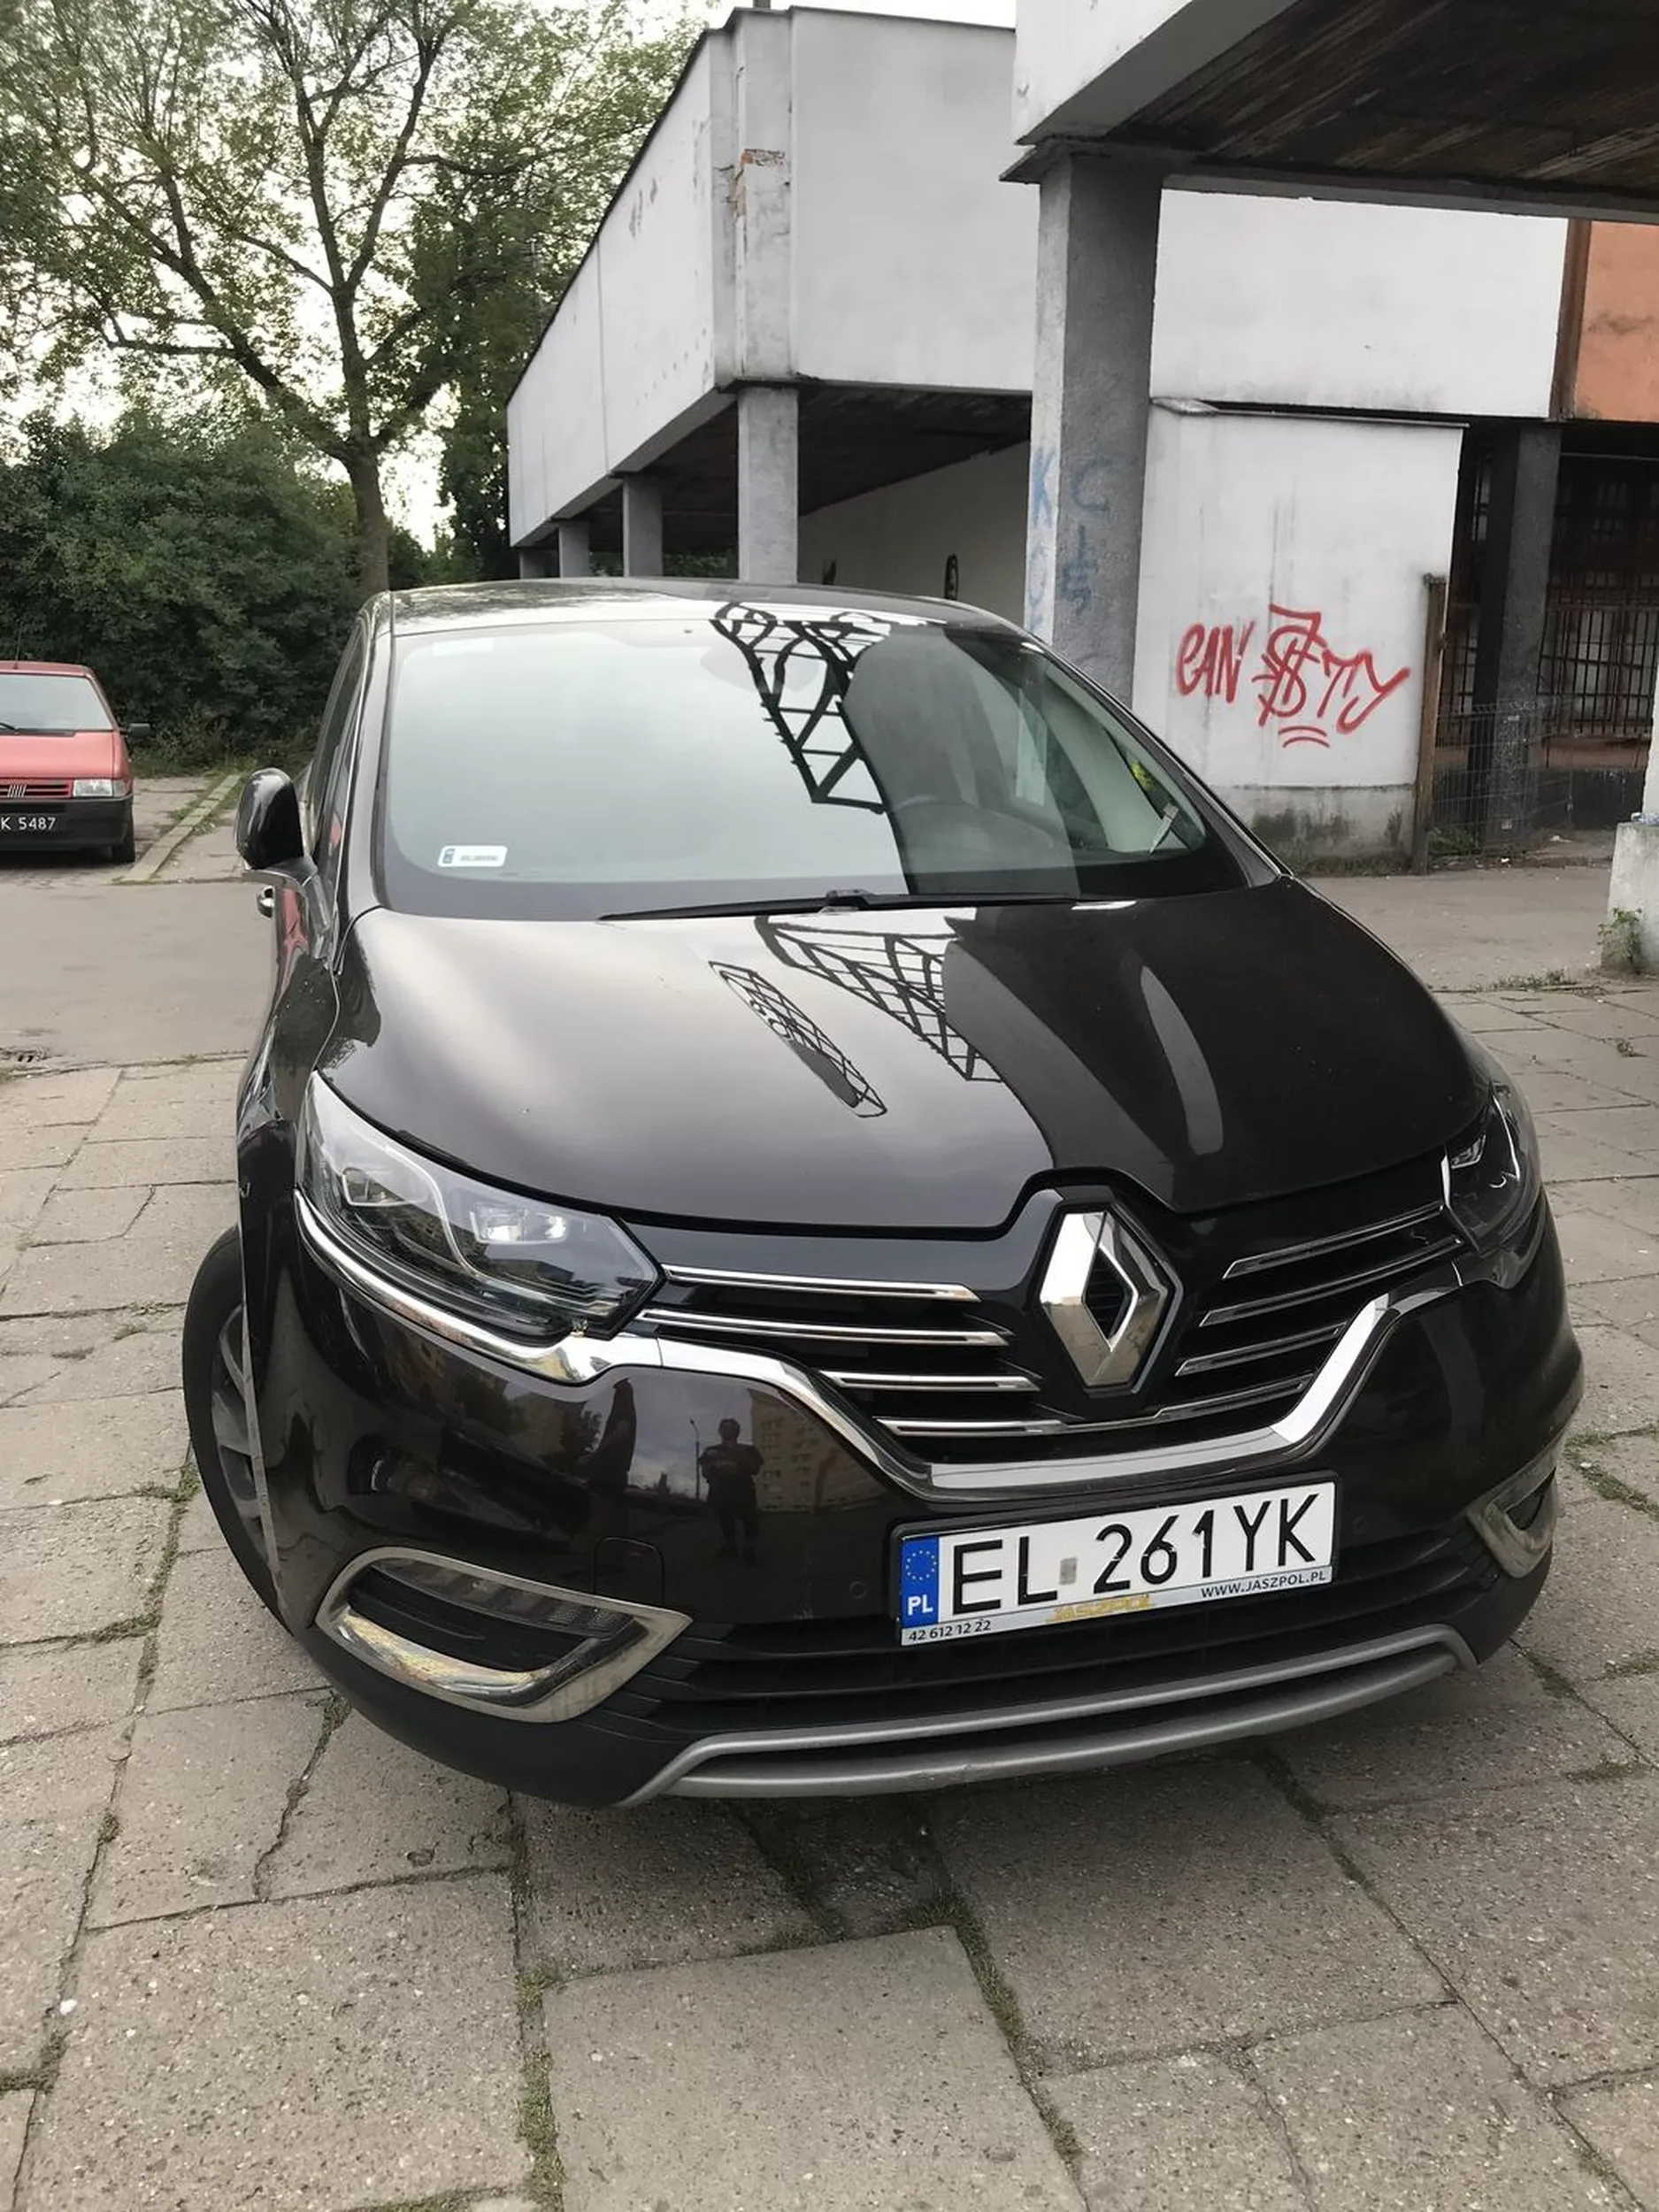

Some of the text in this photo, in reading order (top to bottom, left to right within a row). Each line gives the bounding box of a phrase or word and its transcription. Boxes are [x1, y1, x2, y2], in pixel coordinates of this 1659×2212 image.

[1, 817, 56, 831] K 5487
[952, 1493, 1320, 1616] EL 261YK
[1200, 1570, 1326, 1599] WWW.JASZPOL.PL
[907, 1594, 933, 1617] PL
[909, 1620, 992, 1642] 42 612 12 22
